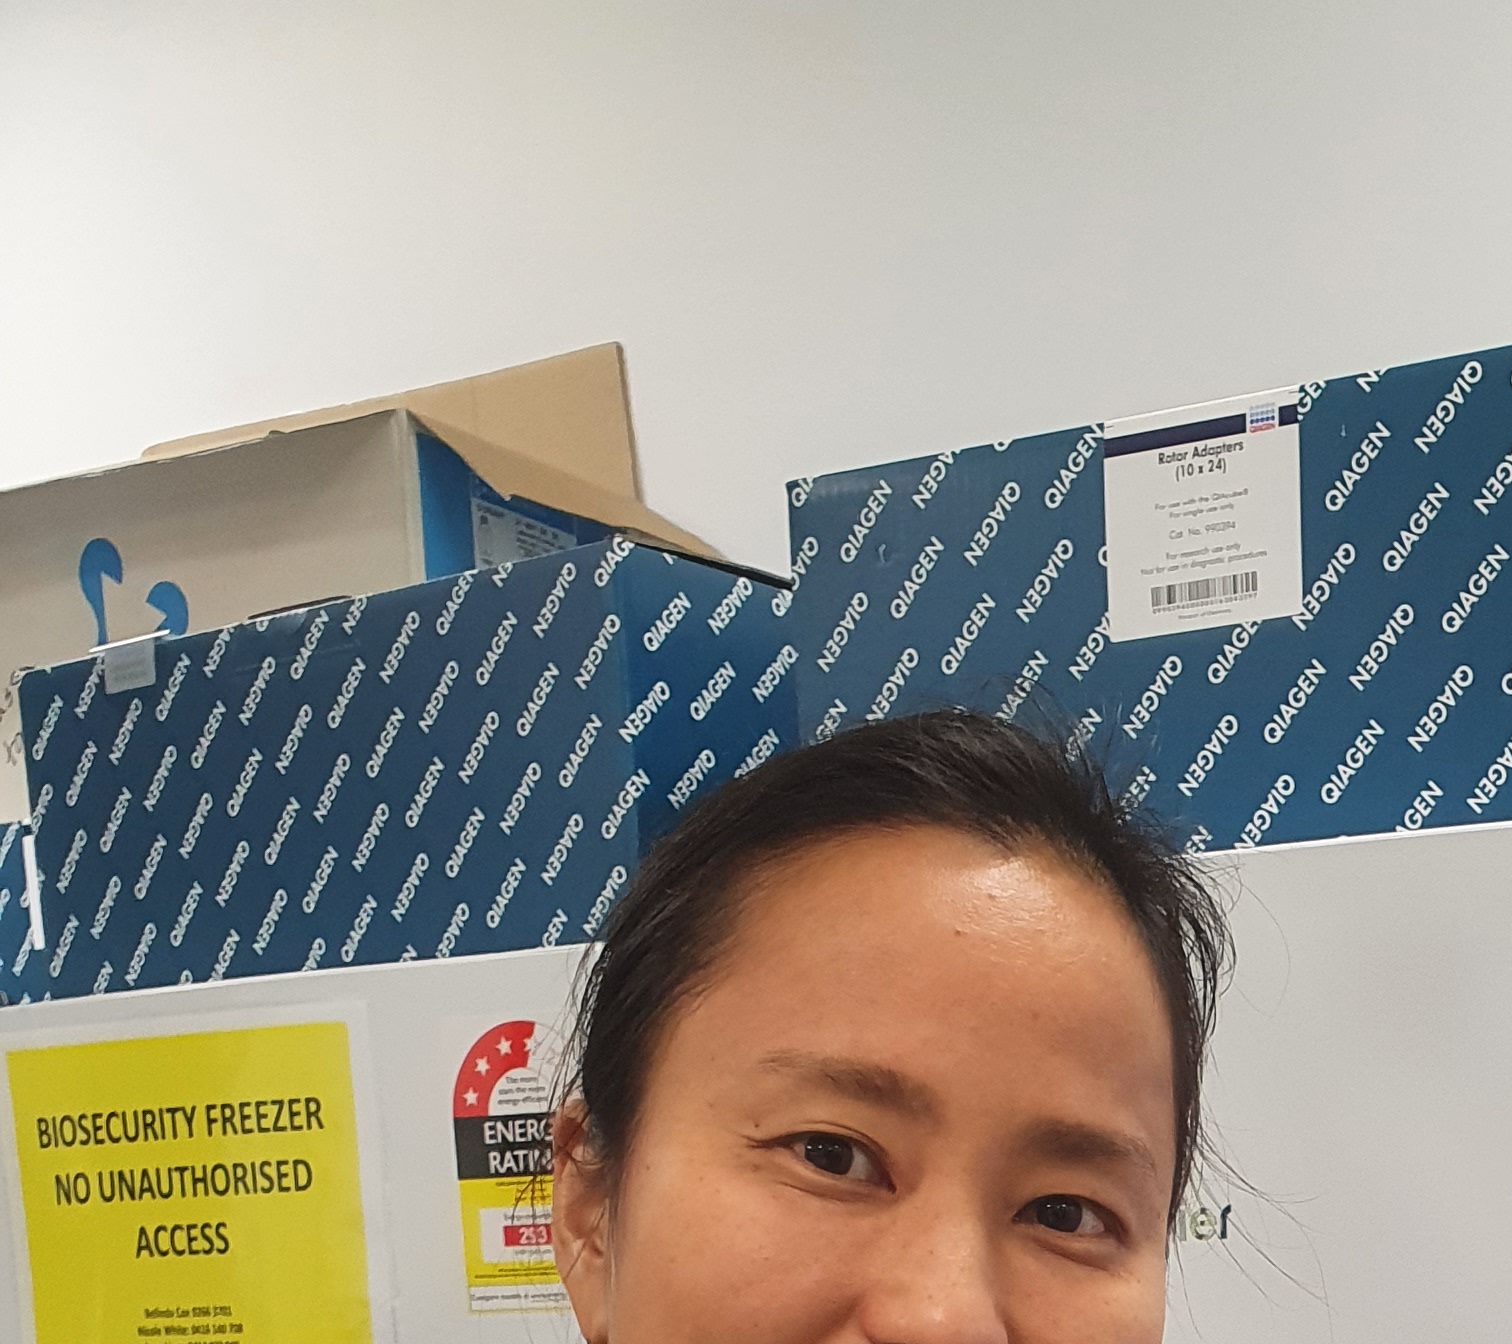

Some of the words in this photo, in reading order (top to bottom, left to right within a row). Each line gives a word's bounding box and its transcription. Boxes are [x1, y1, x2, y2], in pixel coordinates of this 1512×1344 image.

[1414, 361, 1482, 453] QIAGEN
[1044, 423, 1104, 510] QIAGEN
[1158, 451, 1188, 464] Rotor
[1192, 441, 1244, 459] Adapters
[1175, 463, 1194, 482] (10
[1198, 465, 1204, 474] x
[1208, 458, 1227, 474] 24)
[1326, 422, 1391, 511] QIAGEN
[841, 480, 892, 562] QIAGEN
[964, 482, 1020, 566] QIAGEN
[1383, 483, 1449, 571] QIAGEN
[533, 563, 576, 638] QIAGEN
[707, 577, 752, 635] QIAGEN
[891, 536, 944, 618] QIAGEN
[1016, 540, 1073, 622] QIAGEN
[1442, 544, 1509, 632] QIAGEN
[379, 611, 419, 684] QIAGEN
[476, 612, 517, 685] QIAGEN
[574, 615, 620, 689] QIAGEN
[644, 592, 691, 651] QIAGEN
[817, 593, 868, 672] QIAGEN
[942, 593, 995, 674] QIAGEN
[1349, 604, 1413, 691] QIAGEN
[419, 661, 458, 733] QIAGEN
[517, 663, 559, 736] QIAGEN
[690, 662, 736, 720] QIAGEN
[752, 645, 799, 703] QIAGEN
[1123, 656, 1182, 739] QIAGEN
[1264, 659, 1326, 743] QIAGEN
[1407, 666, 1473, 752] QIAGEN
[458, 712, 499, 784] QIAGEN
[619, 681, 670, 743] QIAGEN
[559, 714, 602, 787] QIAGEN
[667, 750, 715, 809] QIAGEN
[1178, 715, 1237, 796] QIAGEN
[1321, 720, 1384, 803] QIAGEN
[499, 763, 541, 835] QIAGEN
[601, 769, 650, 839] QIAGEN
[445, 807, 485, 877] QIAGEN
[541, 814, 583, 885] QIAGEN
[36, 1105, 196, 1149] BIOSECURITY
[205, 1097, 325, 1137] FREEZER
[55, 1172, 91, 1206] NO
[98, 1160, 312, 1202] UNAUTHORISED
[136, 1222, 230, 1258] ACCESS
